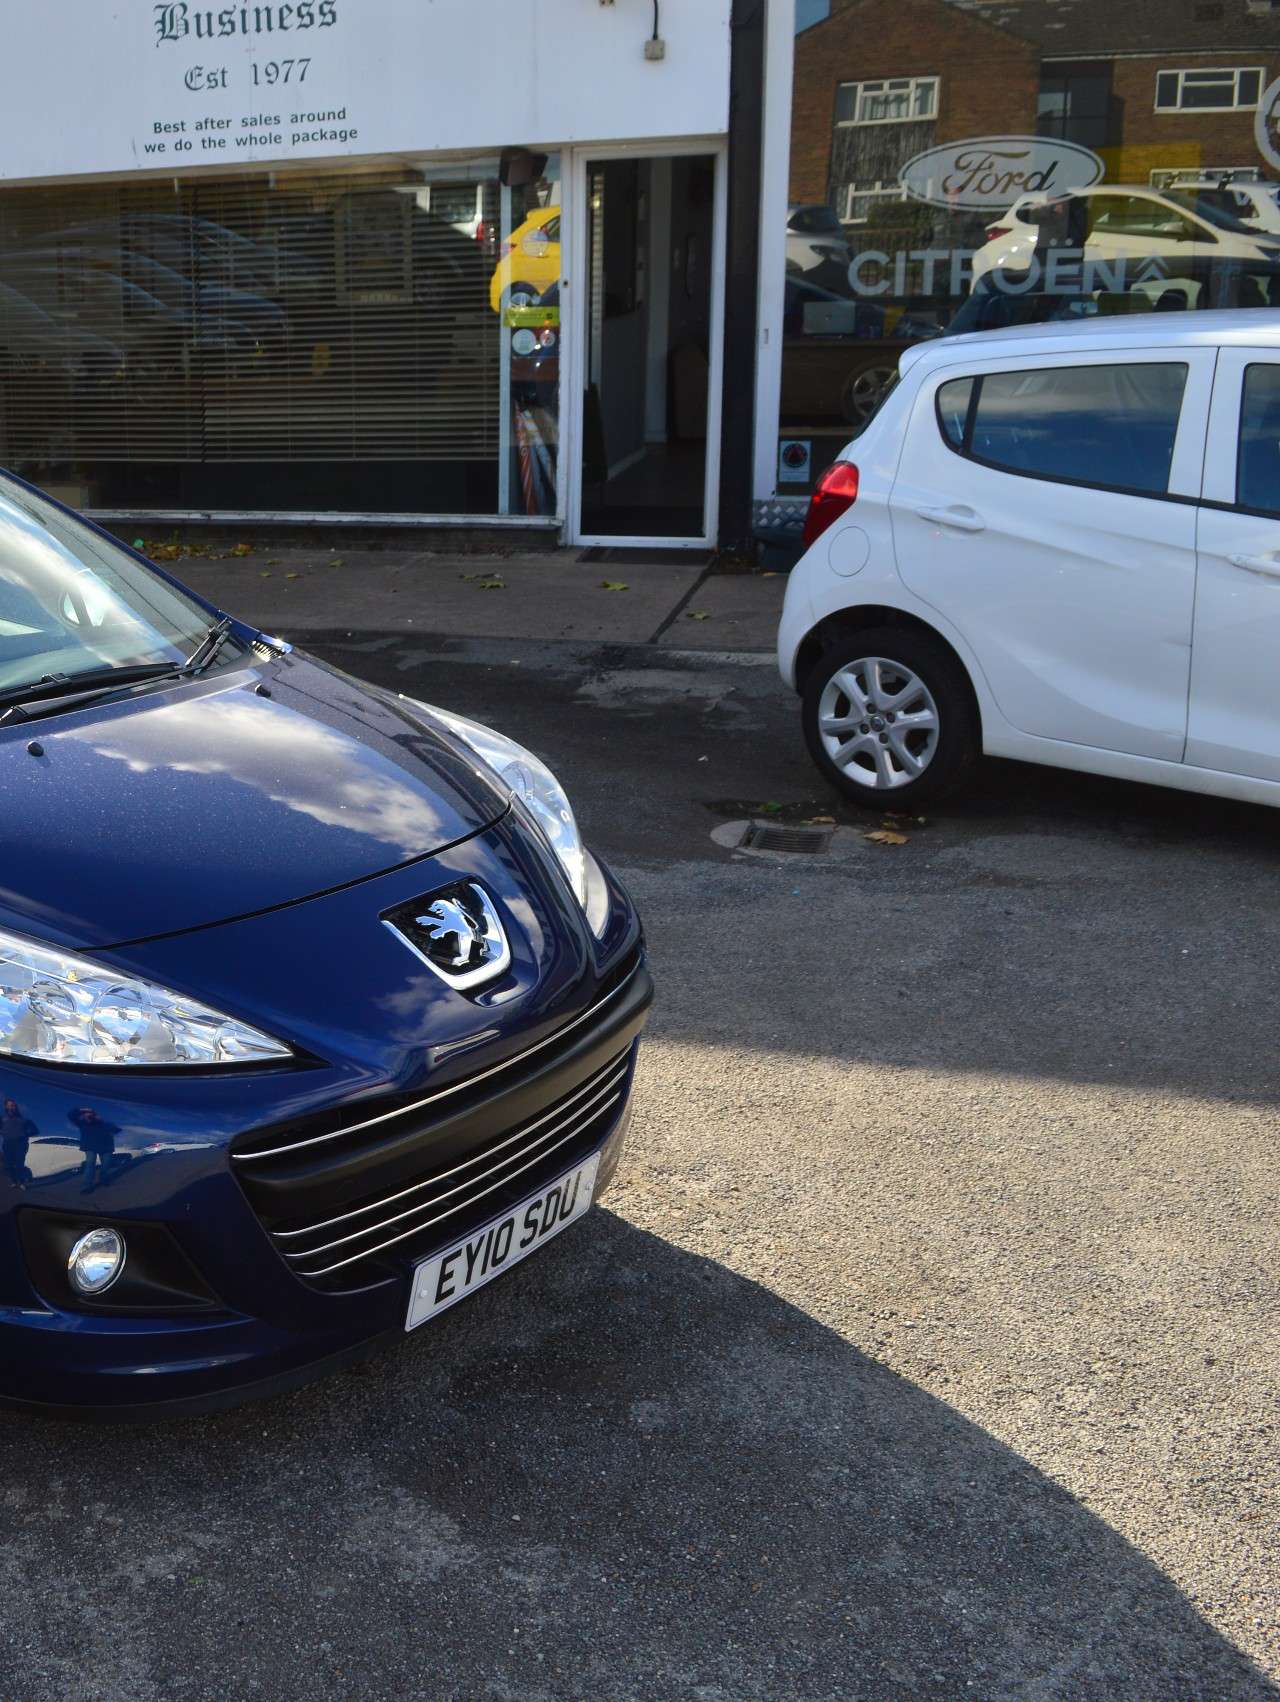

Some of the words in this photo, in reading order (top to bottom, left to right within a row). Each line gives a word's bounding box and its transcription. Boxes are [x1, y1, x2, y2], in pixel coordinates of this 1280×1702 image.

[154, 0, 337, 47] Business
[184, 64, 228, 91] Est
[251, 58, 311, 86] 1977
[144, 142, 166, 153] we
[174, 139, 192, 152] do
[201, 137, 226, 150] the
[235, 133, 282, 147] whole
[291, 127, 358, 145] package
[153, 121, 186, 134] Best
[194, 117, 232, 131] after
[241, 113, 281, 128] sales
[290, 107, 347, 124] around
[942, 149, 1059, 195] Ford
[434, 1217, 515, 1305] EY10
[520, 1171, 582, 1249] SDU
